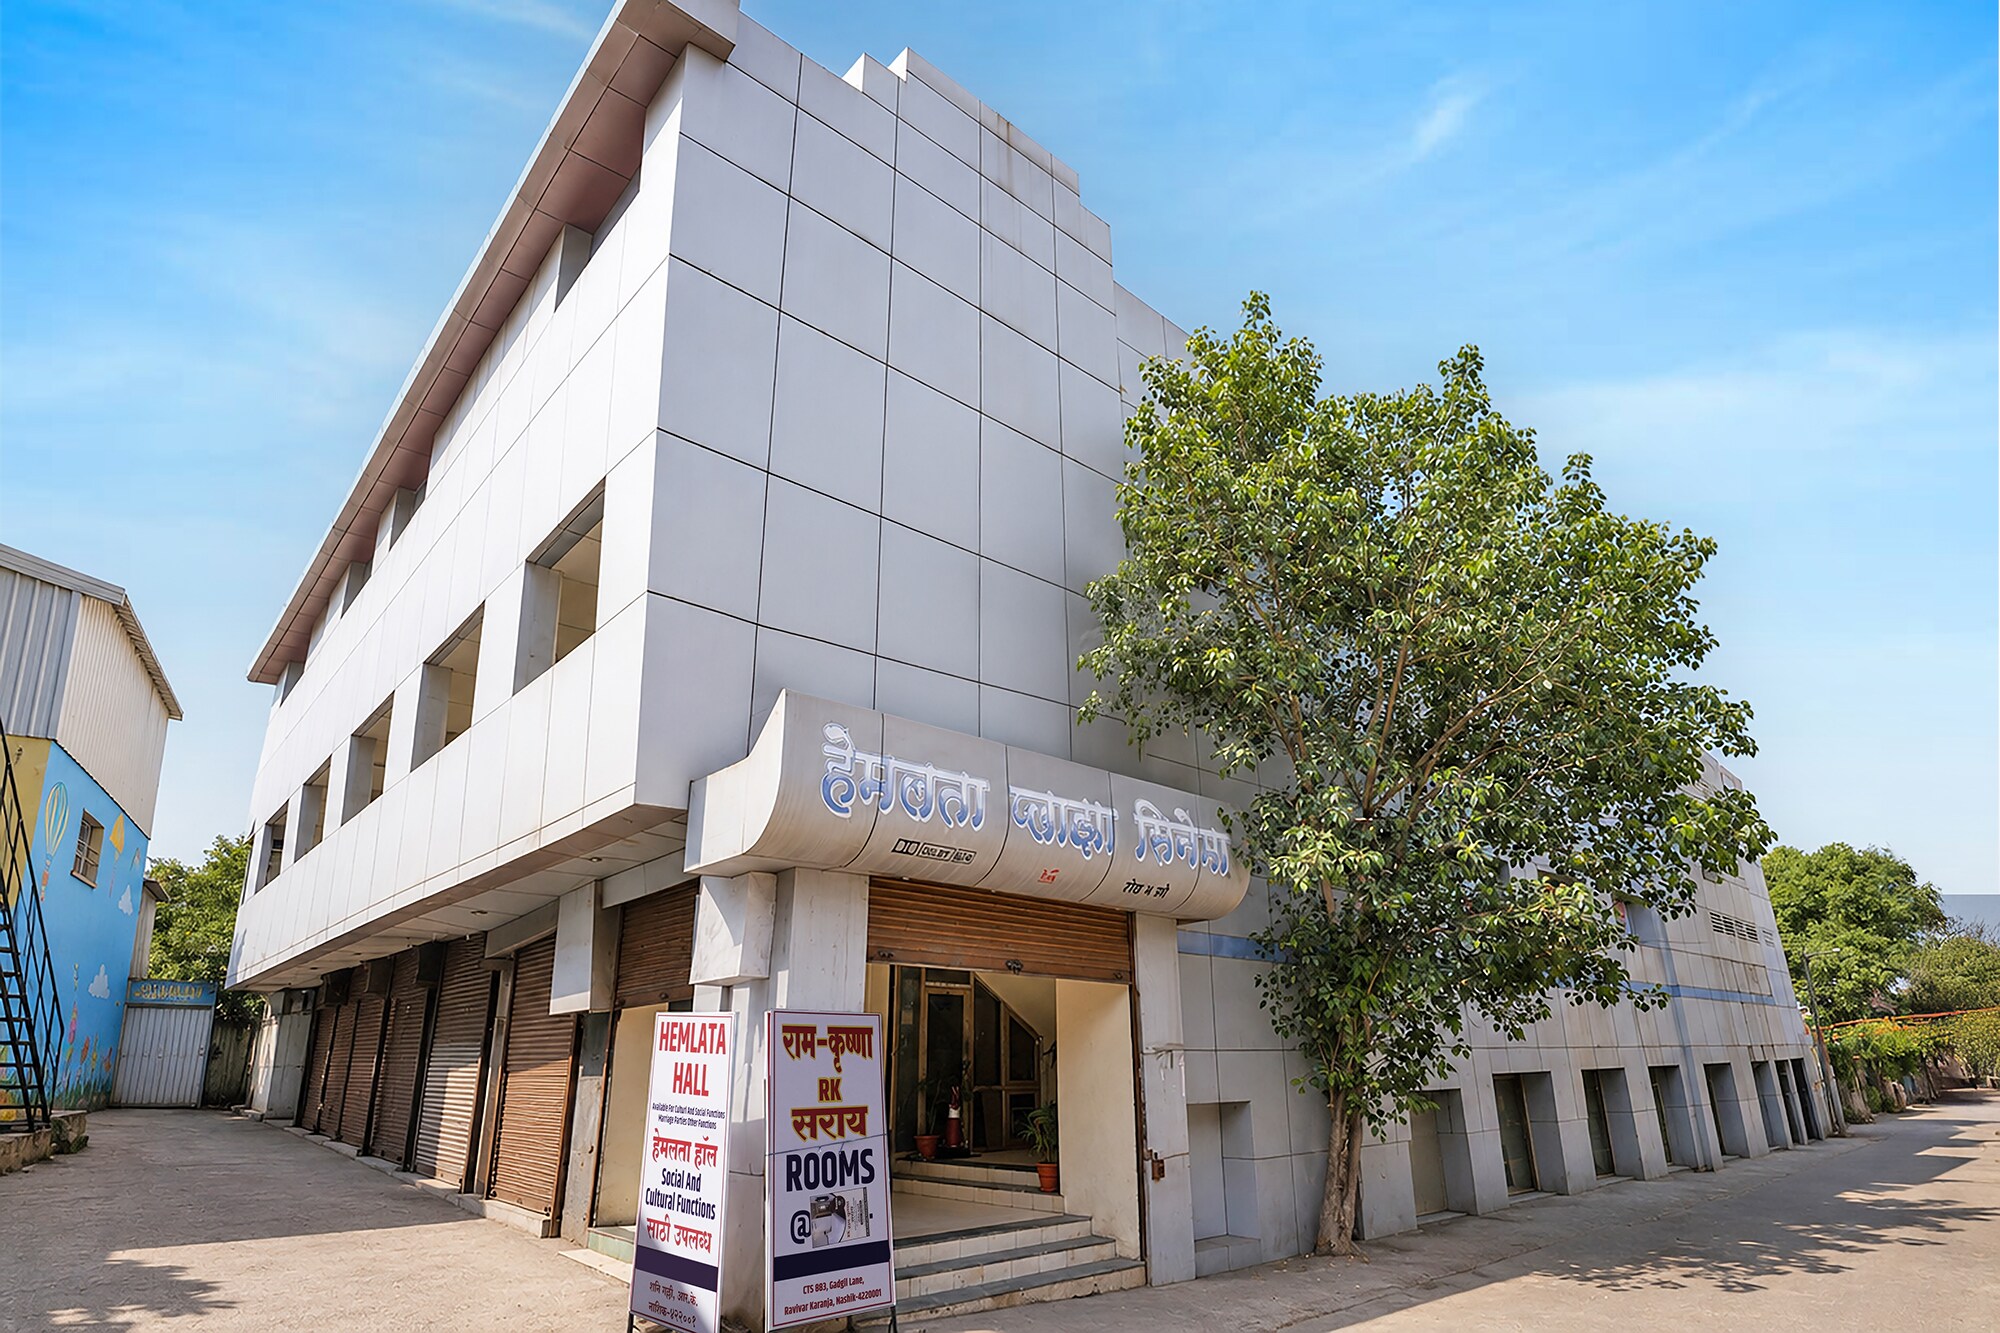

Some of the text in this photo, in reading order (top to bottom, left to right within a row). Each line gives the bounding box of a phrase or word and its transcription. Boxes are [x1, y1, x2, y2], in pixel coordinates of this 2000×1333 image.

[820, 721, 991, 832] हेमलता
[1133, 798, 1231, 877] सिनेमा
[659, 1021, 726, 1055] HEMLATA
[782, 1024, 873, 1073] राम-कृष्णा
[672, 1062, 709, 1097] HALL
[818, 1077, 843, 1102] RK
[652, 1102, 669, 1112] Available
[687, 1106, 695, 1116] And
[695, 1107, 707, 1118] Social
[706, 1109, 725, 1119] Functions
[657, 1114, 717, 1130] Marriage Parties Other Functions
[791, 1105, 868, 1141] सराय
[652, 1128, 718, 1170] हेमलता हॉल
[661, 1168, 702, 1193] Social And
[786, 1148, 875, 1192] ROOMS
[645, 1187, 716, 1220] Cultural Functions
[646, 1213, 713, 1254] साठी उपलब्ध
[803, 1284, 814, 1295] CTS
[829, 1277, 848, 1290] Gadgil
[849, 1276, 865, 1287] Lane,
[784, 1303, 809, 1316] Ravivar
[809, 1297, 835, 1310] Karanja,
